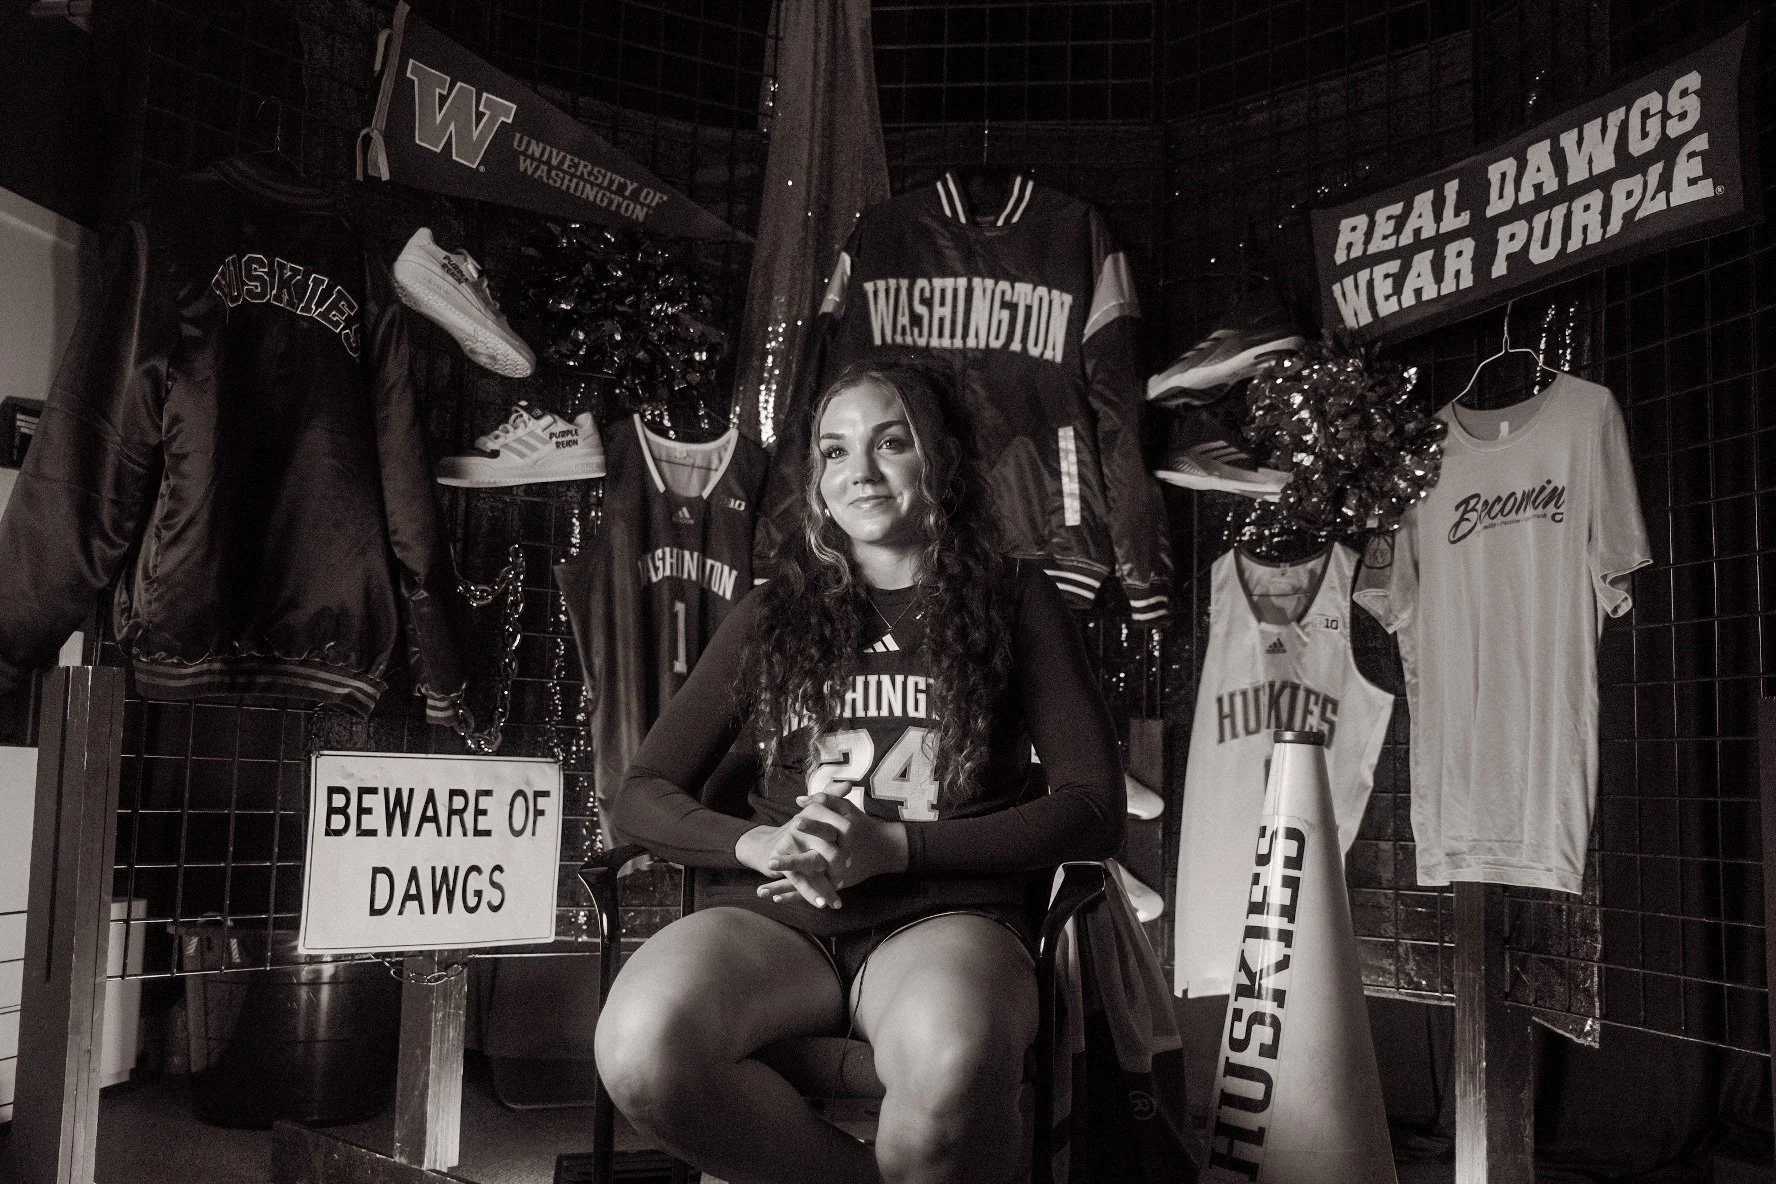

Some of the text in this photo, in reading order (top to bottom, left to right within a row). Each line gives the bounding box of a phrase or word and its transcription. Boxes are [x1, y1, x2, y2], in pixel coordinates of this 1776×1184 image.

[513, 132, 668, 207] UNIVERSITY OF
[518, 155, 651, 222] WASHINGTON
[1333, 70, 1702, 267] REAL DAWGS
[863, 277, 1073, 363] WASHINGTON
[1331, 236, 1476, 331] WEAR
[548, 428, 580, 441] PURPLE
[673, 600, 688, 675] 1
[324, 785, 551, 837] BEWARE OF
[807, 725, 942, 823] 24
[369, 864, 506, 917] DAWGS
[1208, 825, 1306, 1183] HUSKIES
